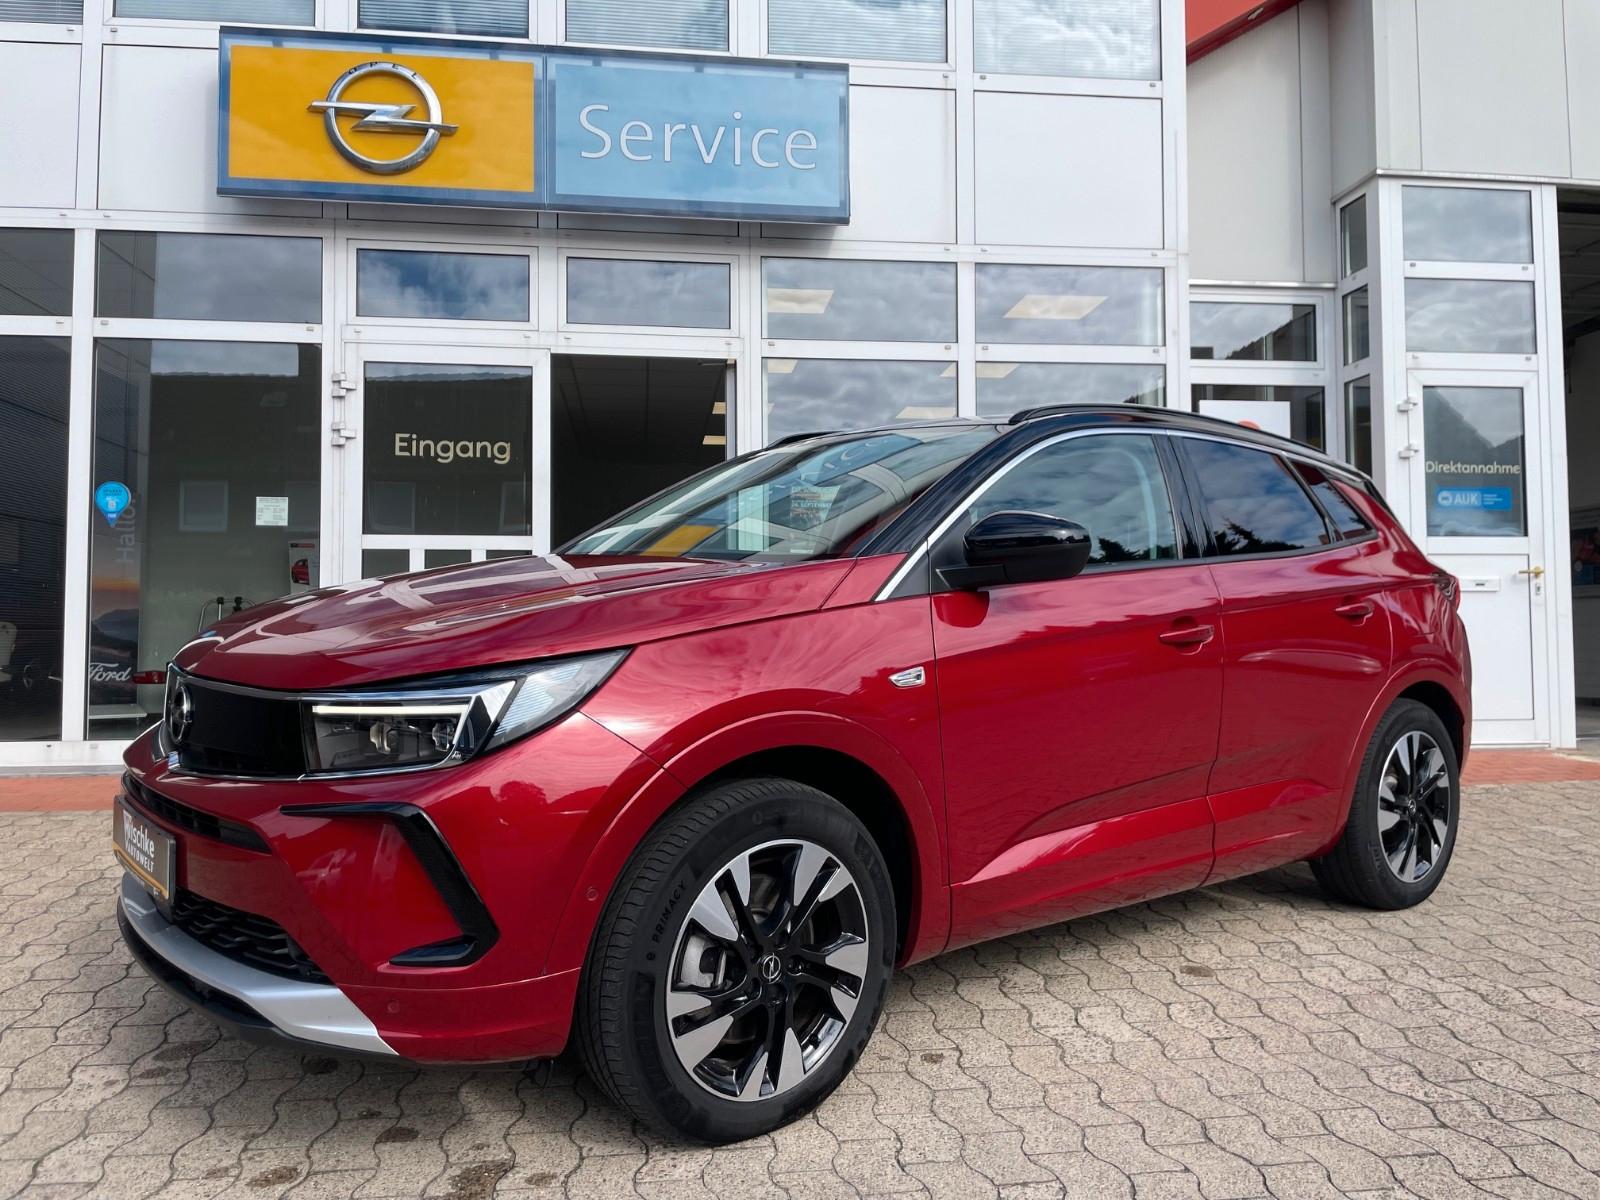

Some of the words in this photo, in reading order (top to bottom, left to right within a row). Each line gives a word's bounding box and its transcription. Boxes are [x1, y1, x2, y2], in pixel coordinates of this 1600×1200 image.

[348, 61, 417, 80] OPEL
[578, 103, 818, 170] Service
[394, 433, 511, 465] Eingang
[1425, 461, 1521, 475] Direktannahme
[1453, 493, 1479, 505] AUK
[90, 662, 132, 681] Ford
[126, 842, 155, 873] AUTOWELT
[652, 880, 687, 945] PRIMACY
